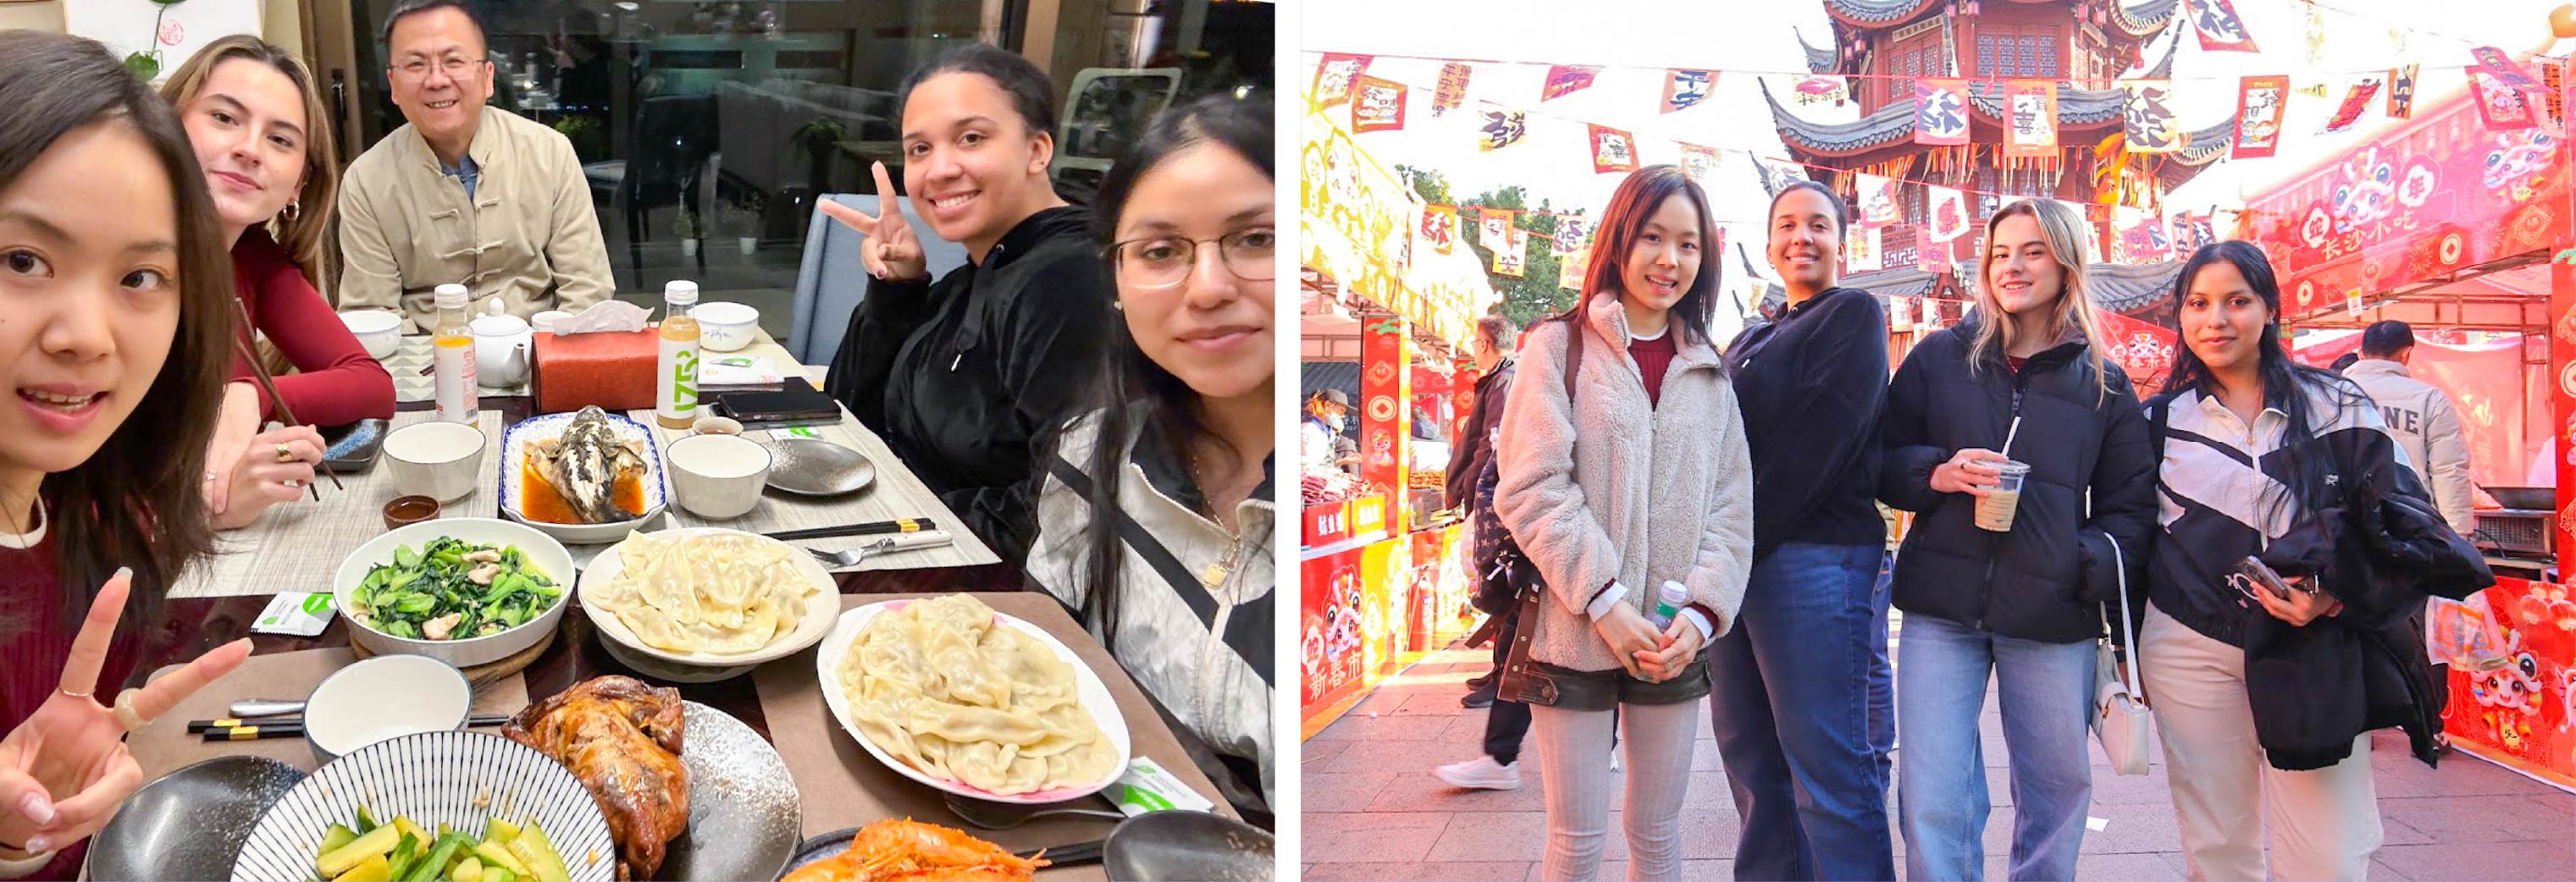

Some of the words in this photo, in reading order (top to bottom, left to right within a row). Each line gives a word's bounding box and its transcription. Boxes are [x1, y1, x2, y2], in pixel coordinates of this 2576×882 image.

[2321, 209, 2418, 260] 长沙小吃
[1309, 650, 1363, 701] 新春市
